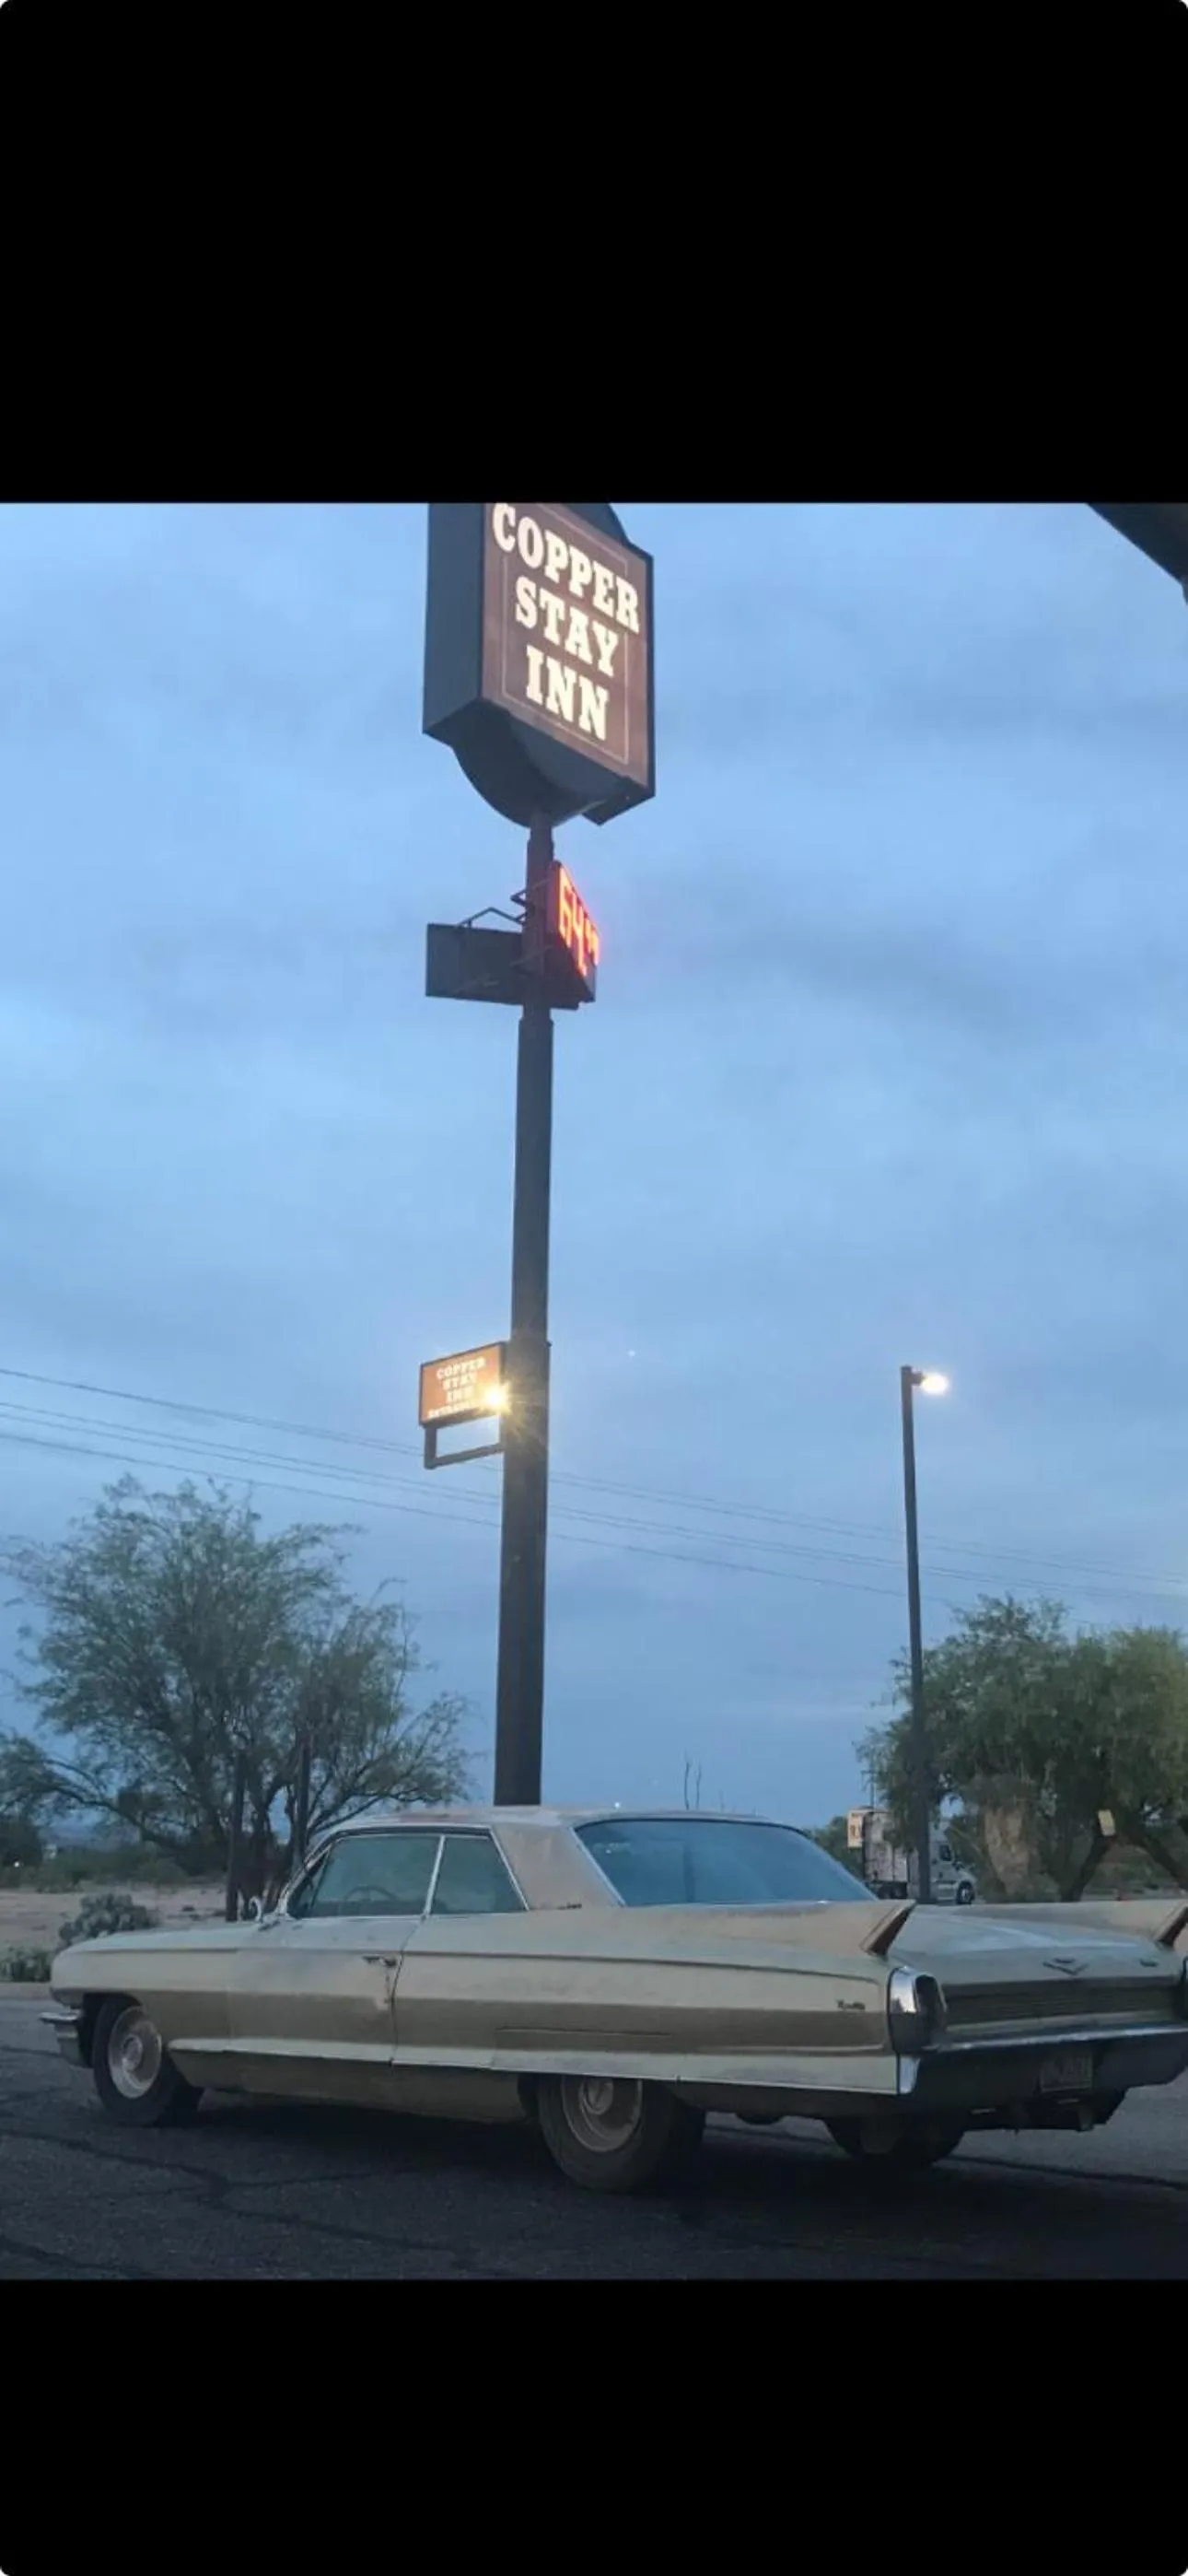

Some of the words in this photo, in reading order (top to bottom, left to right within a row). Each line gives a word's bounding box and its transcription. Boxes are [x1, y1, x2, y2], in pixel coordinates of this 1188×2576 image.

[493, 503, 639, 634] COPPER
[516, 576, 618, 676] STAY
[526, 644, 609, 741] INN
